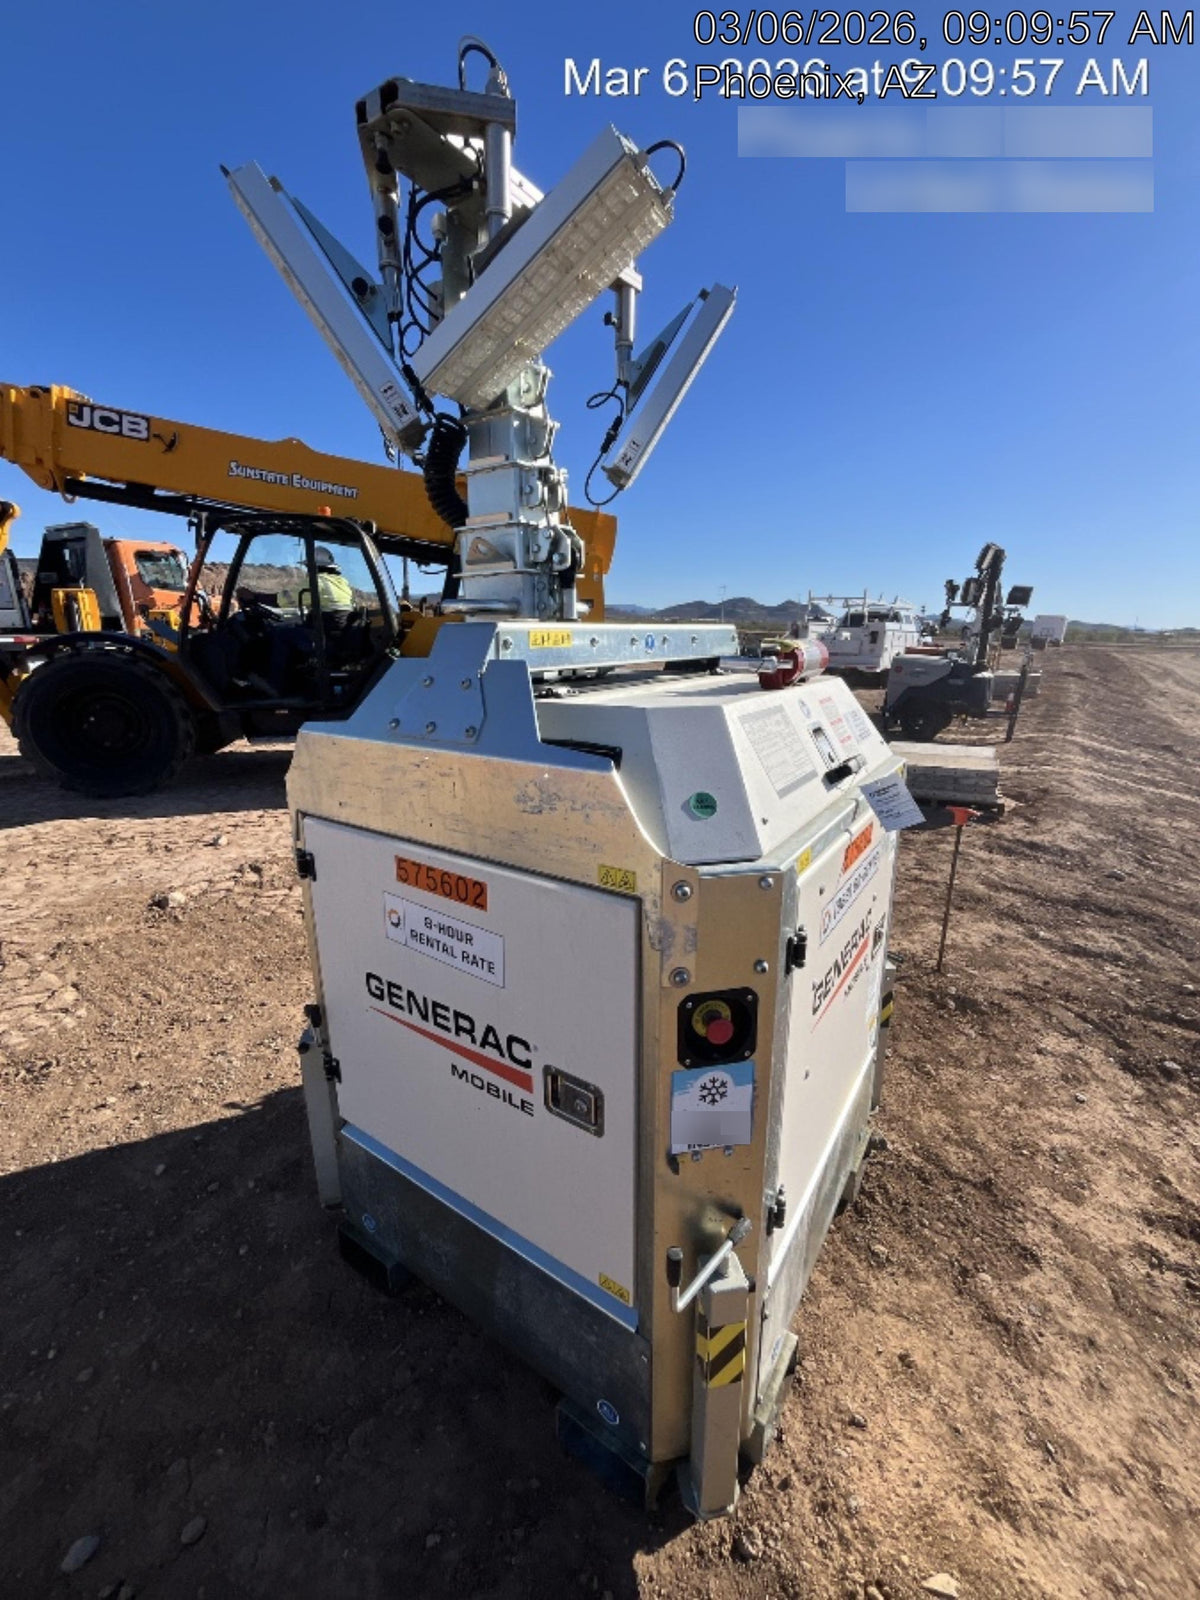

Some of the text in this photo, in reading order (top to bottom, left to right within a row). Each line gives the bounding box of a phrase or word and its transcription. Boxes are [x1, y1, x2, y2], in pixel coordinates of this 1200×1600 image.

[69, 406, 149, 439] JCB
[398, 860, 485, 909] 575602
[410, 928, 495, 975] RENTAL RATE
[424, 916, 474, 946] 8-HOUR
[365, 971, 532, 1069] GENERAC
[451, 1063, 534, 1117] MOBILE
